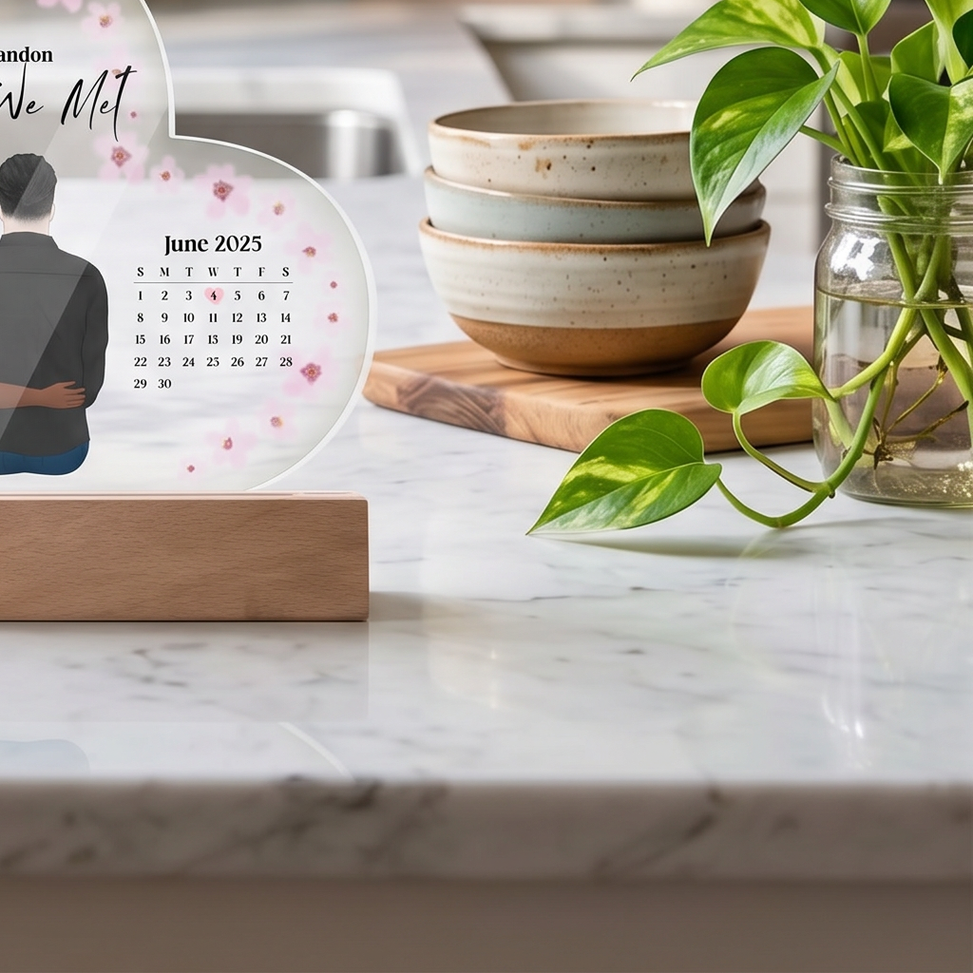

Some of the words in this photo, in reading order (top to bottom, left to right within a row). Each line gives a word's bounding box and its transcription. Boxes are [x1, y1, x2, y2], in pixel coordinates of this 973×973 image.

[60, 65, 137, 141] Met
[164, 235, 209, 257] June
[214, 234, 262, 253] 2025
[136, 266, 145, 277] S
[159, 266, 170, 277] M
[184, 266, 194, 277] T
[207, 266, 219, 277] W
[233, 266, 242, 277] T
[258, 266, 266, 277] F
[281, 266, 290, 278] S
[161, 290, 169, 301] 2
[185, 290, 193, 301] 3
[210, 290, 217, 301] 4
[233, 290, 242, 301] 5
[257, 290, 266, 301] 6
[283, 290, 290, 301] 7
[136, 312, 145, 323] 8
[161, 312, 169, 323] 9
[183, 312, 195, 323] 10
[209, 312, 218, 323] 11
[232, 312, 243, 323] 12
[256, 312, 267, 323] 13
[280, 312, 291, 323] 14
[135, 334, 146, 345] 15
[159, 334, 171, 345] 16
[184, 334, 195, 345] 17
[231, 334, 243, 345] 19
[254, 334, 269, 345] 20
[280, 334, 292, 345] 21
[133, 356, 148, 367] 22
[157, 356, 172, 368] 23
[182, 356, 195, 367] 24
[206, 356, 220, 367] 25
[230, 356, 245, 368] 26
[255, 356, 269, 367] 27
[279, 356, 293, 368] 28
[133, 378, 148, 389] 29
[157, 378, 172, 389] 30
